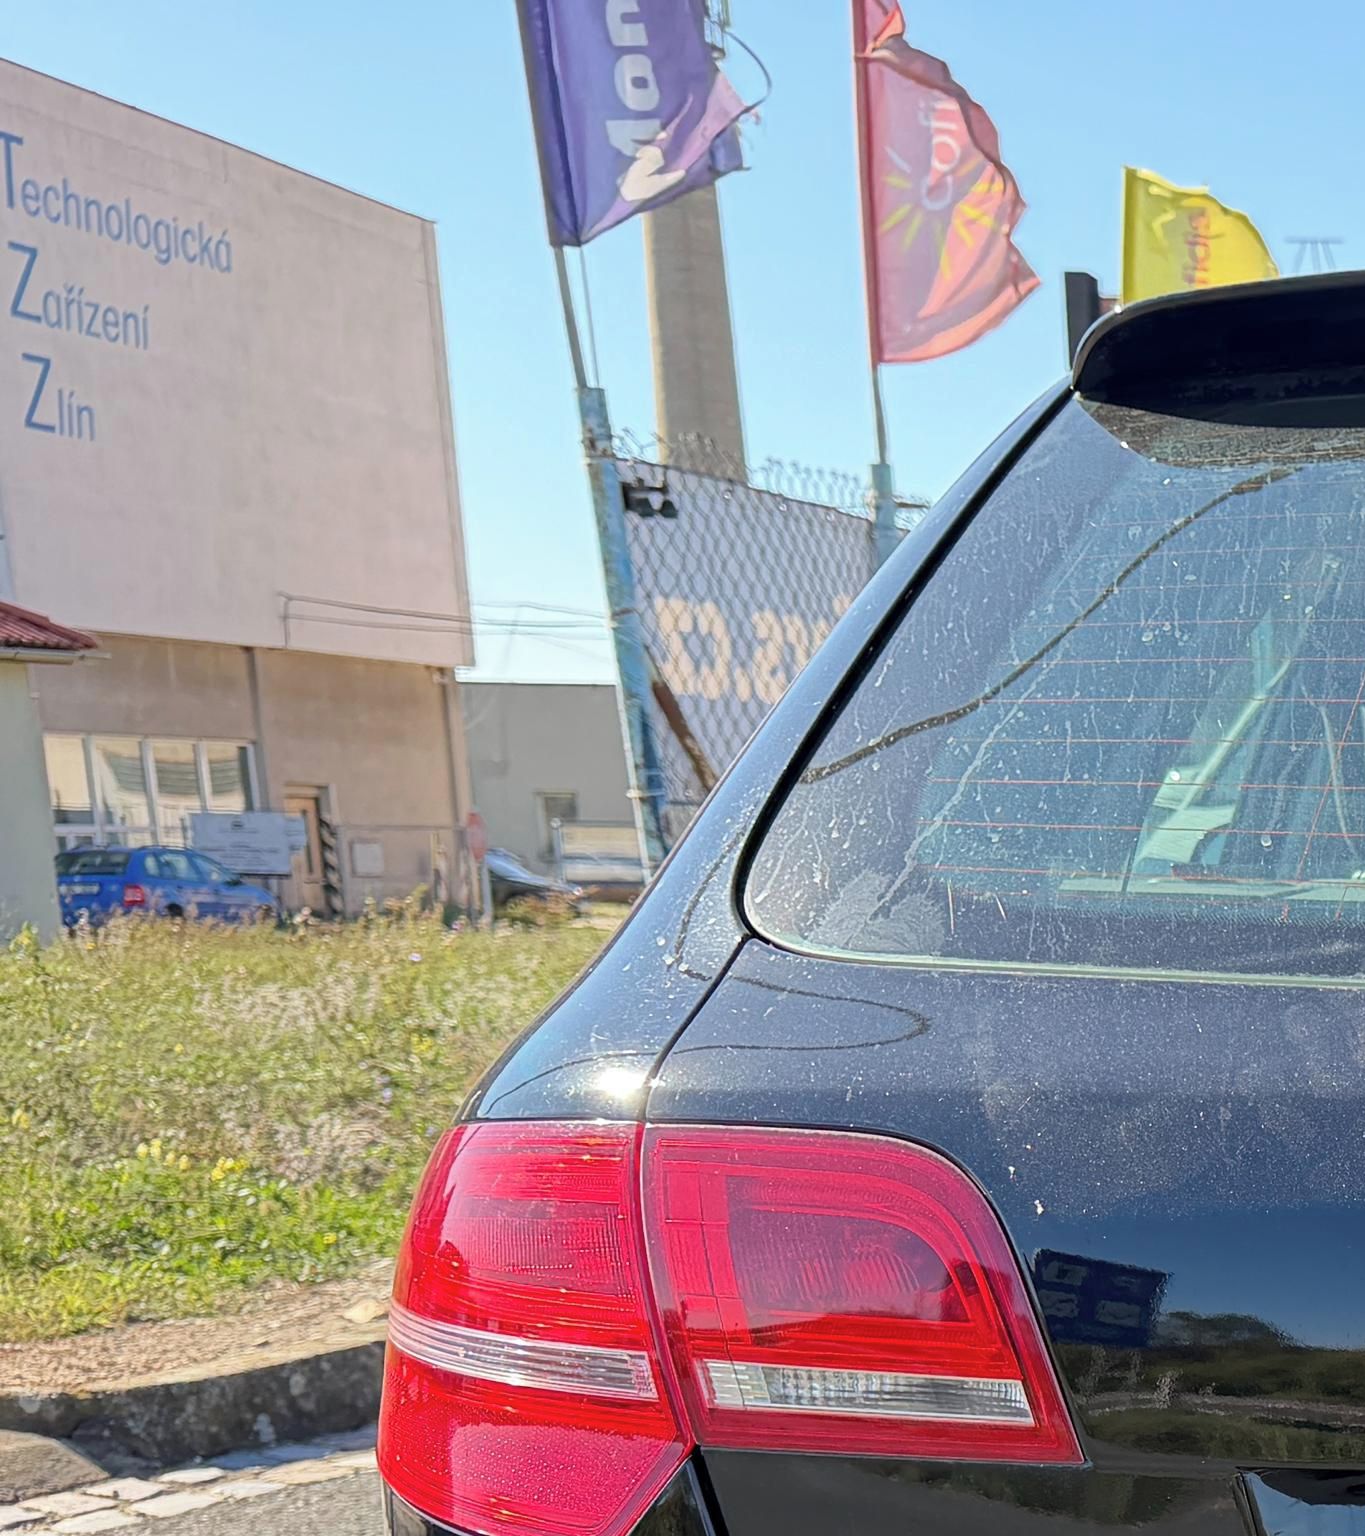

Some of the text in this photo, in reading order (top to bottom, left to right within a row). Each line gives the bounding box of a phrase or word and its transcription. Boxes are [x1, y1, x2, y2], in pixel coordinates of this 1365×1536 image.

[0, 131, 233, 274] Technologická
[8, 240, 150, 350] Zařízení
[22, 352, 96, 442] Zlín
